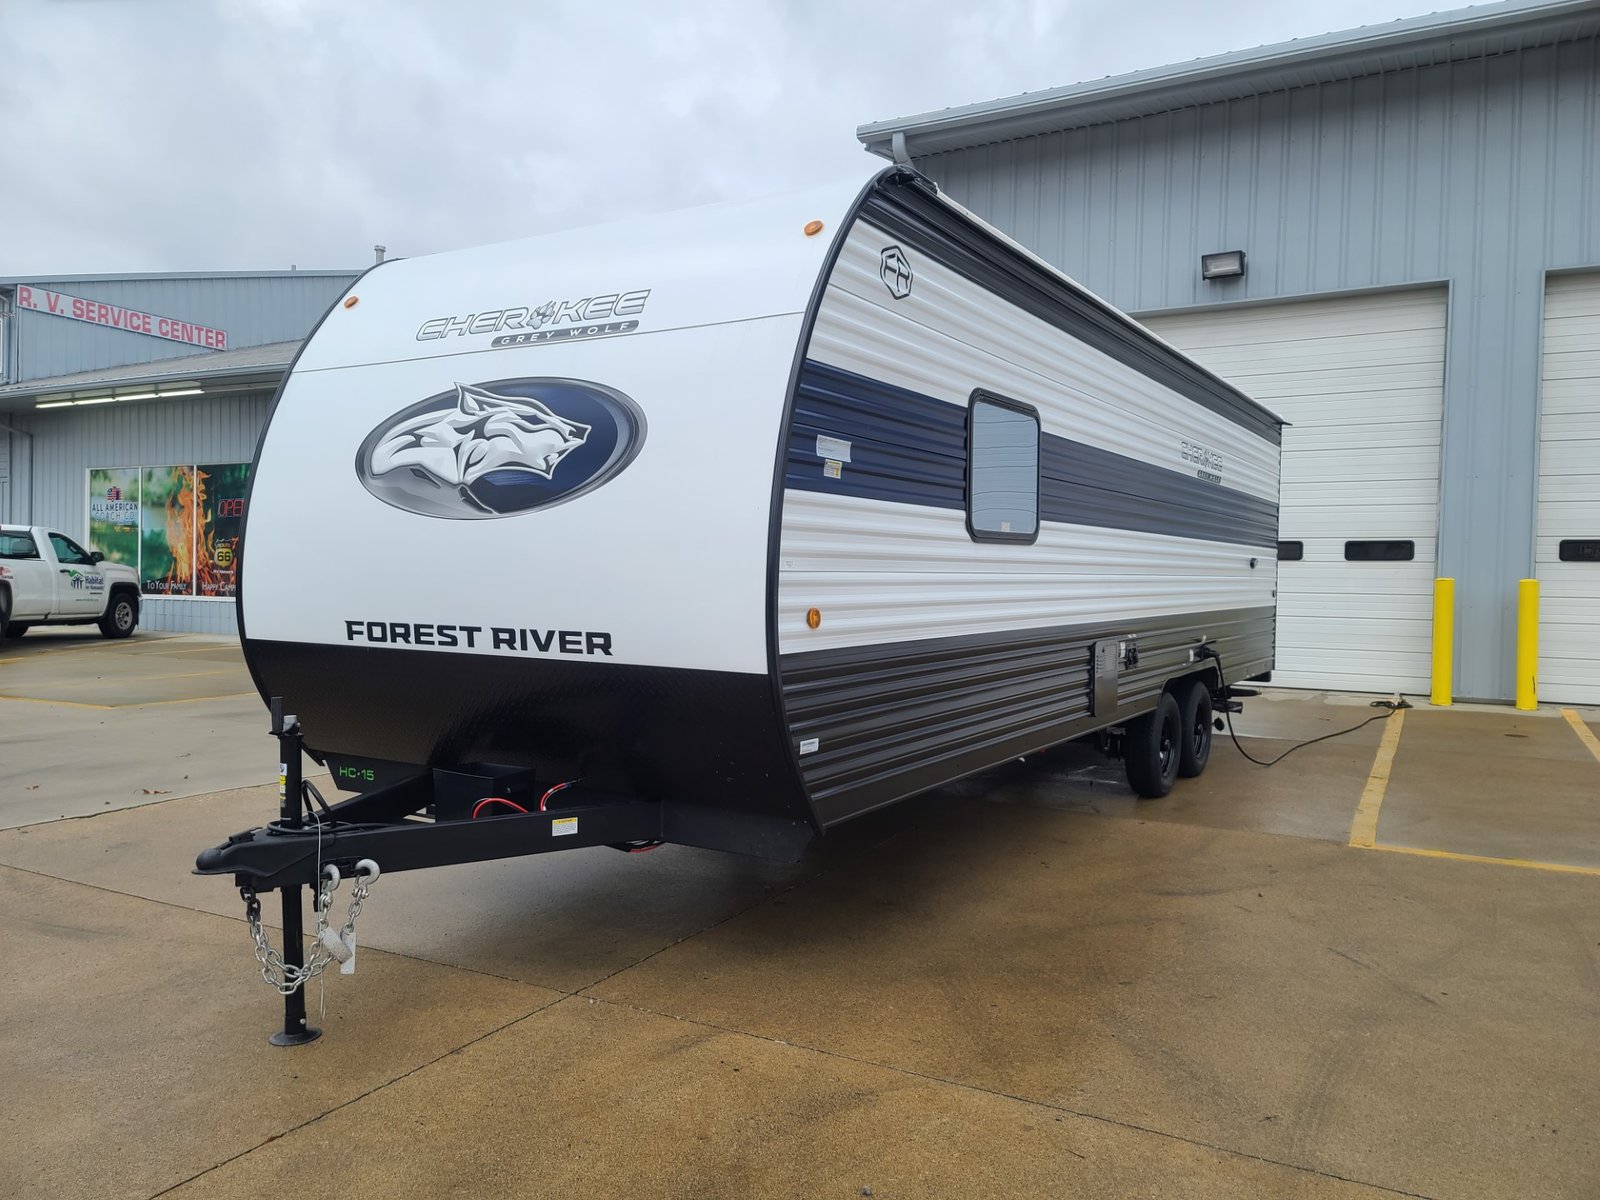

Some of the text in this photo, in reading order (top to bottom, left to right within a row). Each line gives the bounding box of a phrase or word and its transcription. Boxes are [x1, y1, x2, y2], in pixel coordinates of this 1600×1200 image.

[18, 286, 226, 348] R. V. SERVICE CENTER
[500, 321, 630, 345] GREY WOLF
[92, 502, 138, 512] ALL AMERICAN
[218, 498, 243, 517] OPE
[95, 511, 120, 521] COACH
[217, 551, 231, 562] 66
[85, 575, 104, 585] Habitat
[344, 620, 613, 656] FOREST RIVER
